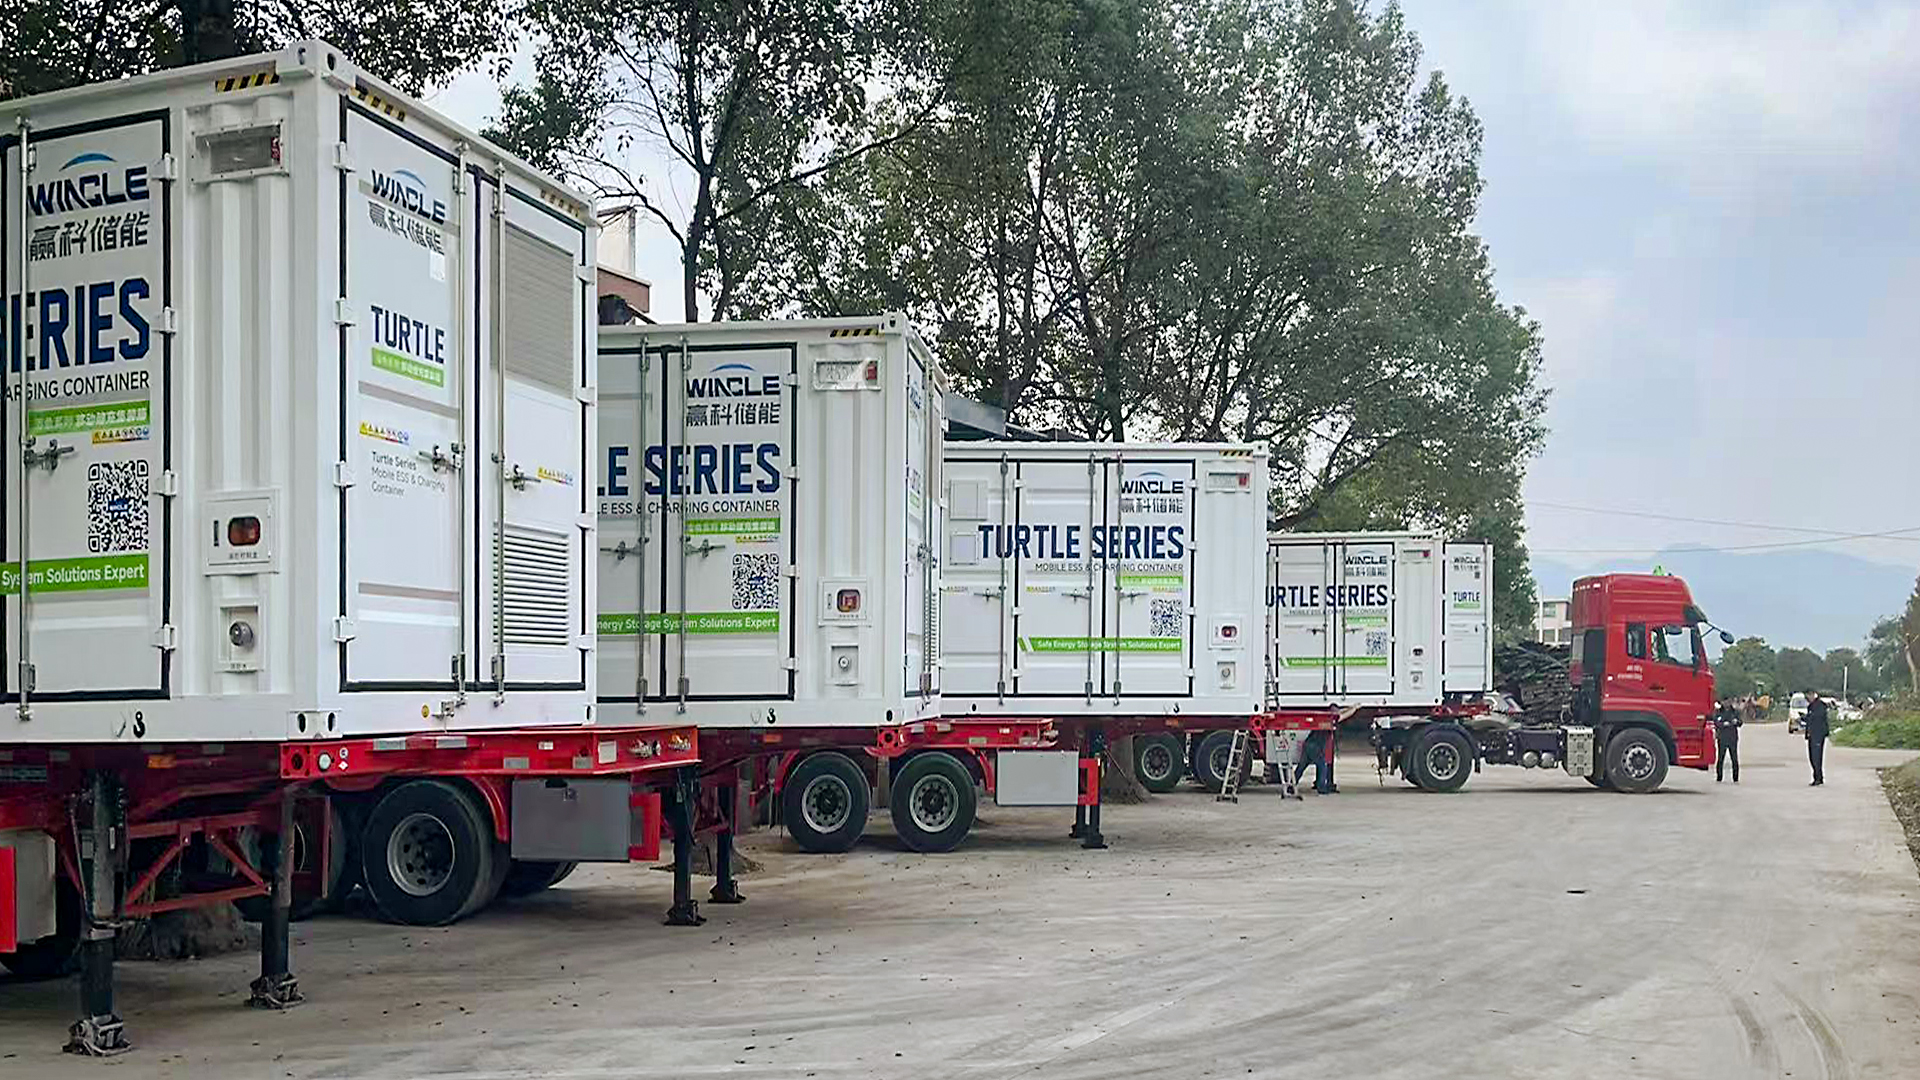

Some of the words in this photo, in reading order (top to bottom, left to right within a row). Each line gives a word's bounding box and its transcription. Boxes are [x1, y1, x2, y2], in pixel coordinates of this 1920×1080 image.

[27, 166, 149, 215] WINCLE
[371, 169, 446, 225] WINCLE
[30, 211, 150, 261] 赢科储能
[0, 278, 150, 374] ERIES
[371, 305, 445, 364] TURTLE
[63, 371, 150, 396] CONTAINER
[686, 376, 781, 398] WINCLE
[372, 451, 393, 466] Turtle
[395, 456, 416, 471] Series
[597, 446, 629, 496] E
[644, 443, 781, 496] SERIES
[372, 466, 394, 481] Mobile
[396, 470, 409, 484] ESS
[372, 481, 405, 496] Container
[1120, 480, 1184, 494] WINCLE
[611, 502, 632, 514] ESS
[648, 500, 709, 514] CHARGING
[712, 500, 780, 512] CONTAINER
[978, 525, 1081, 559] TURTLE
[1091, 525, 1183, 559] SERIES
[2, 570, 44, 589] Sysem
[46, 565, 101, 584] Solutions
[104, 563, 145, 582] Expert
[1036, 563, 1066, 572] MOBILE
[1068, 563, 1082, 572] ESS
[1138, 563, 1183, 572] CONTAINER
[1326, 584, 1388, 607] SERIES
[1453, 591, 1480, 602] TURTLE
[626, 619, 661, 631] Stoage
[663, 618, 698, 631] Sysem
[700, 617, 742, 628] Solutions
[745, 616, 776, 629] Expert
